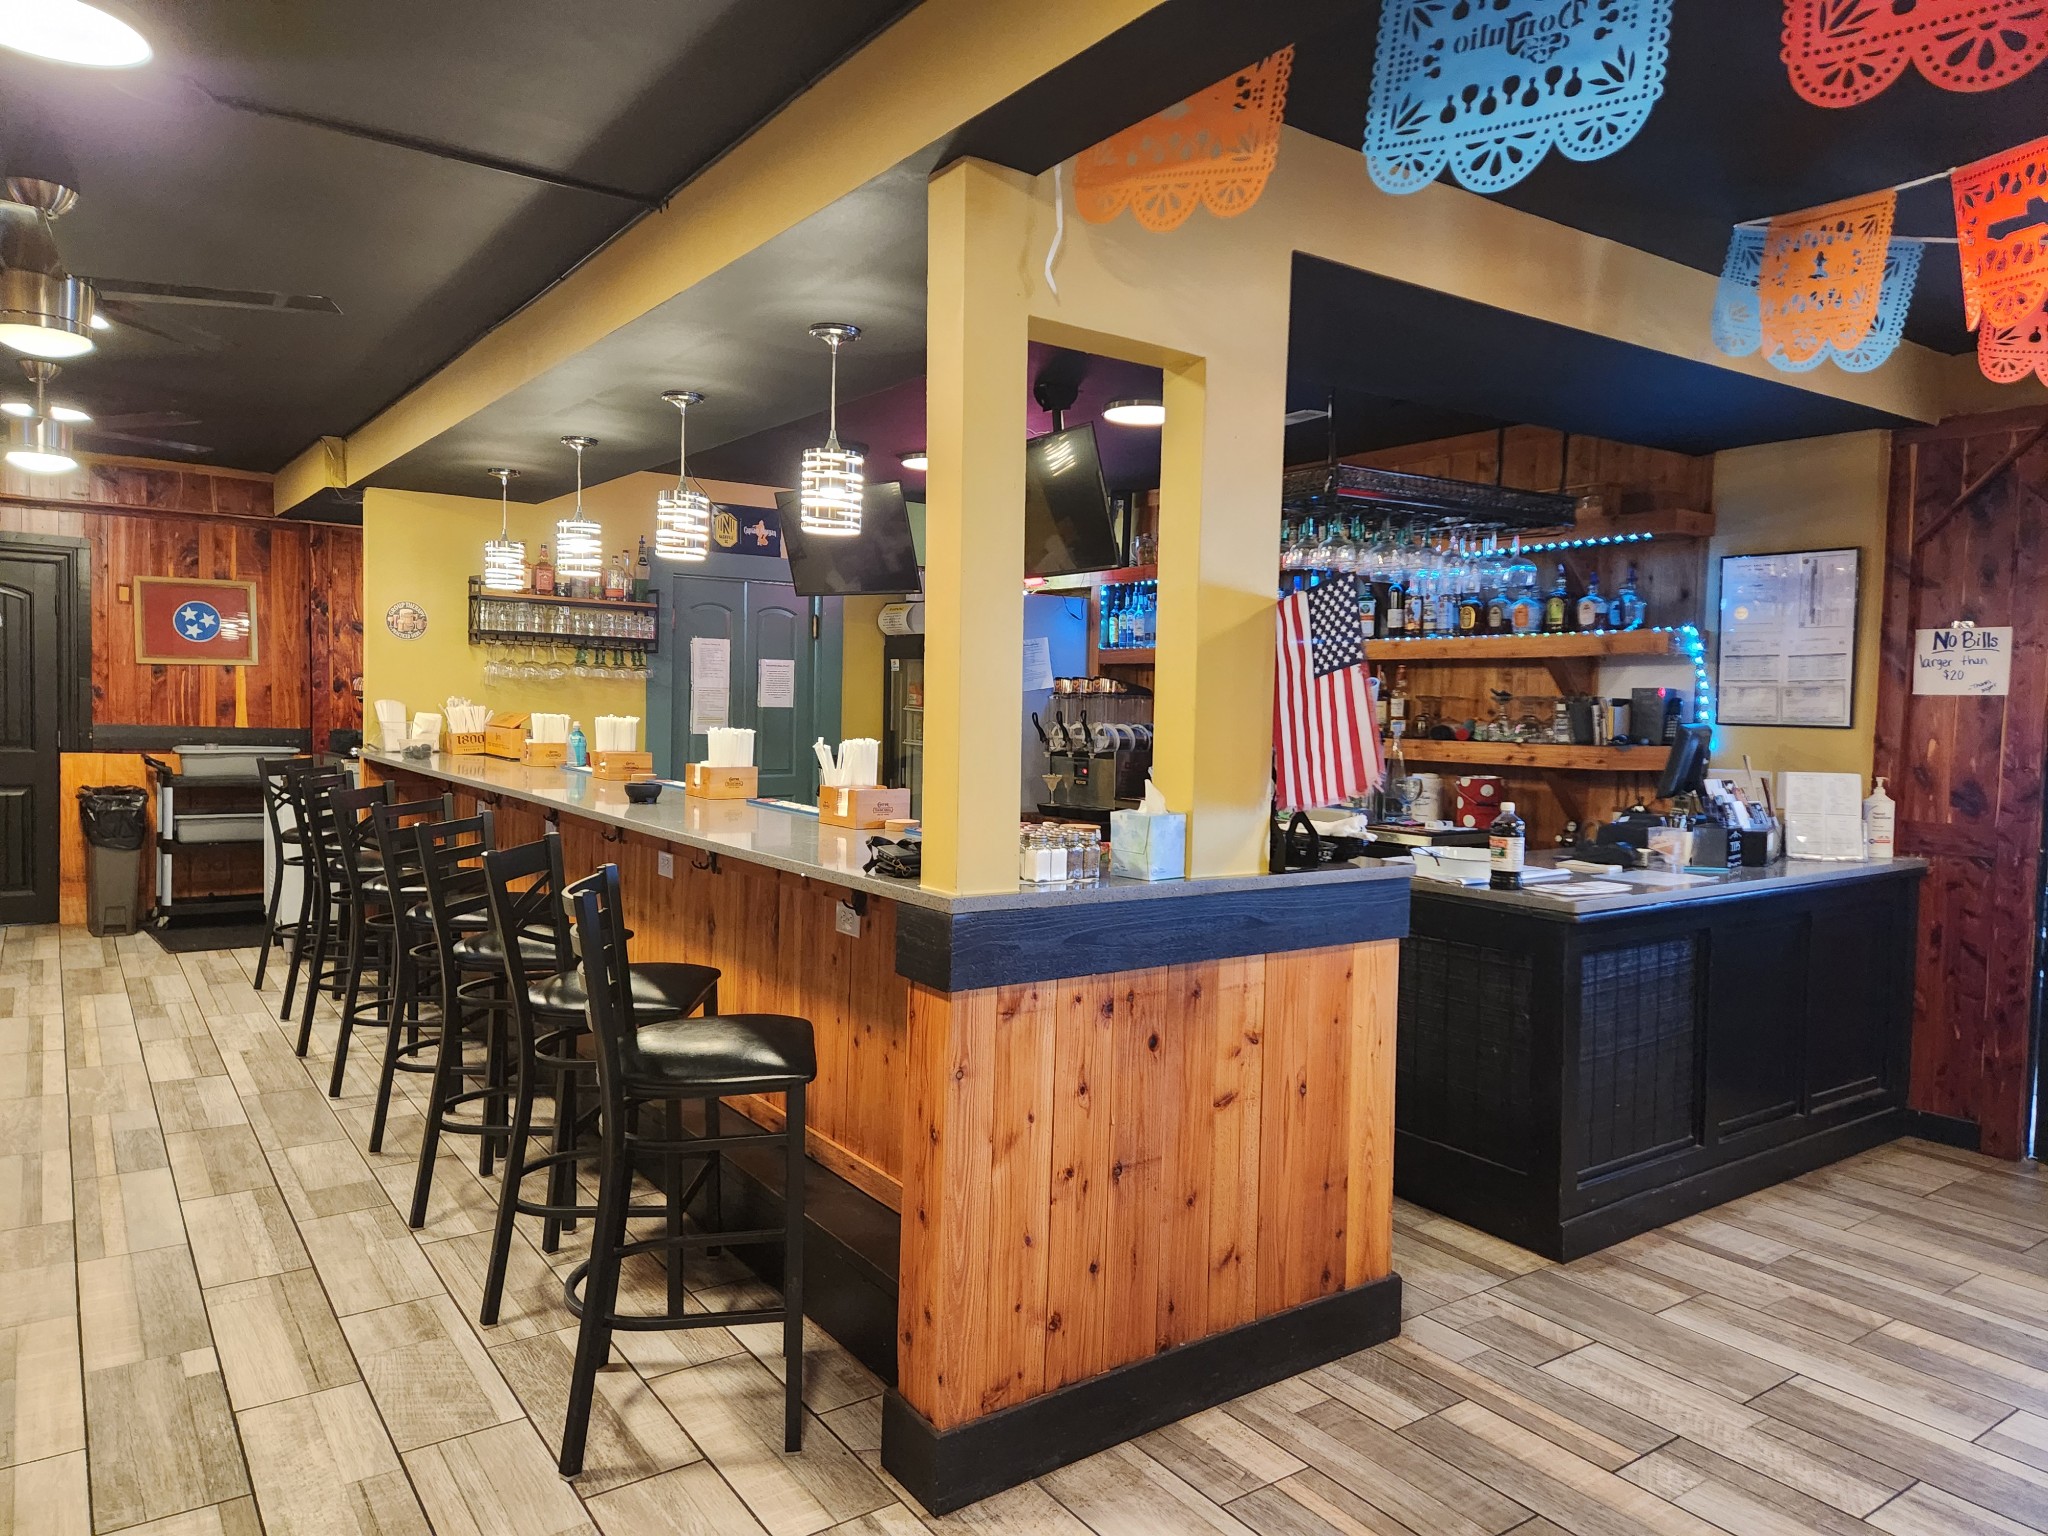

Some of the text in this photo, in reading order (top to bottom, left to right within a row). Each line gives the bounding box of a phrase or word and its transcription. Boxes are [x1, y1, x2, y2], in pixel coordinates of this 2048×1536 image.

[1933, 631, 1999, 650] No Bills
[1919, 654, 1988, 670] larger than
[1943, 670, 1964, 681] $20
[457, 734, 485, 745] 1800
